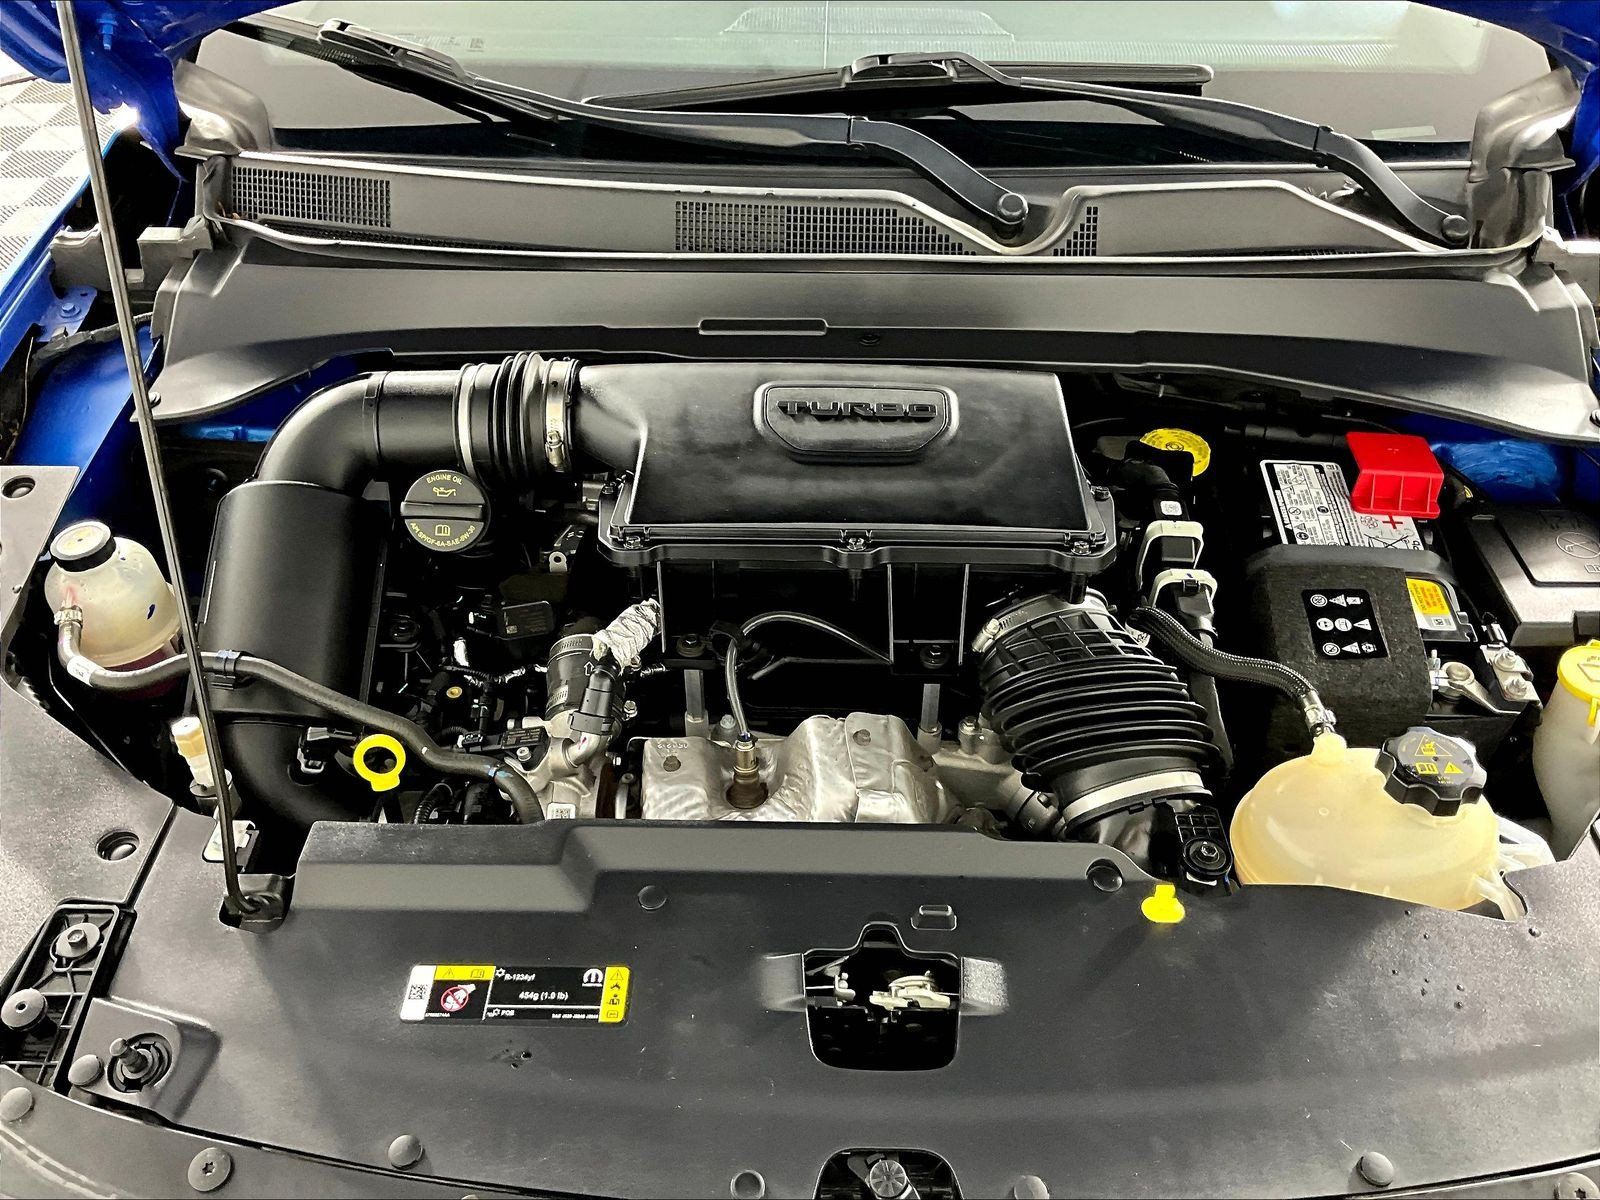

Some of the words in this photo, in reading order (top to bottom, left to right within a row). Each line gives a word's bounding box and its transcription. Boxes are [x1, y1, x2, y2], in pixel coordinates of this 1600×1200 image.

[776, 400, 937, 418] TURBO
[426, 473, 452, 484] ENGINE
[452, 475, 463, 485] OIL
[518, 991, 540, 1001] 454g
[540, 991, 556, 1000] (1.0
[556, 991, 569, 1001] lb)
